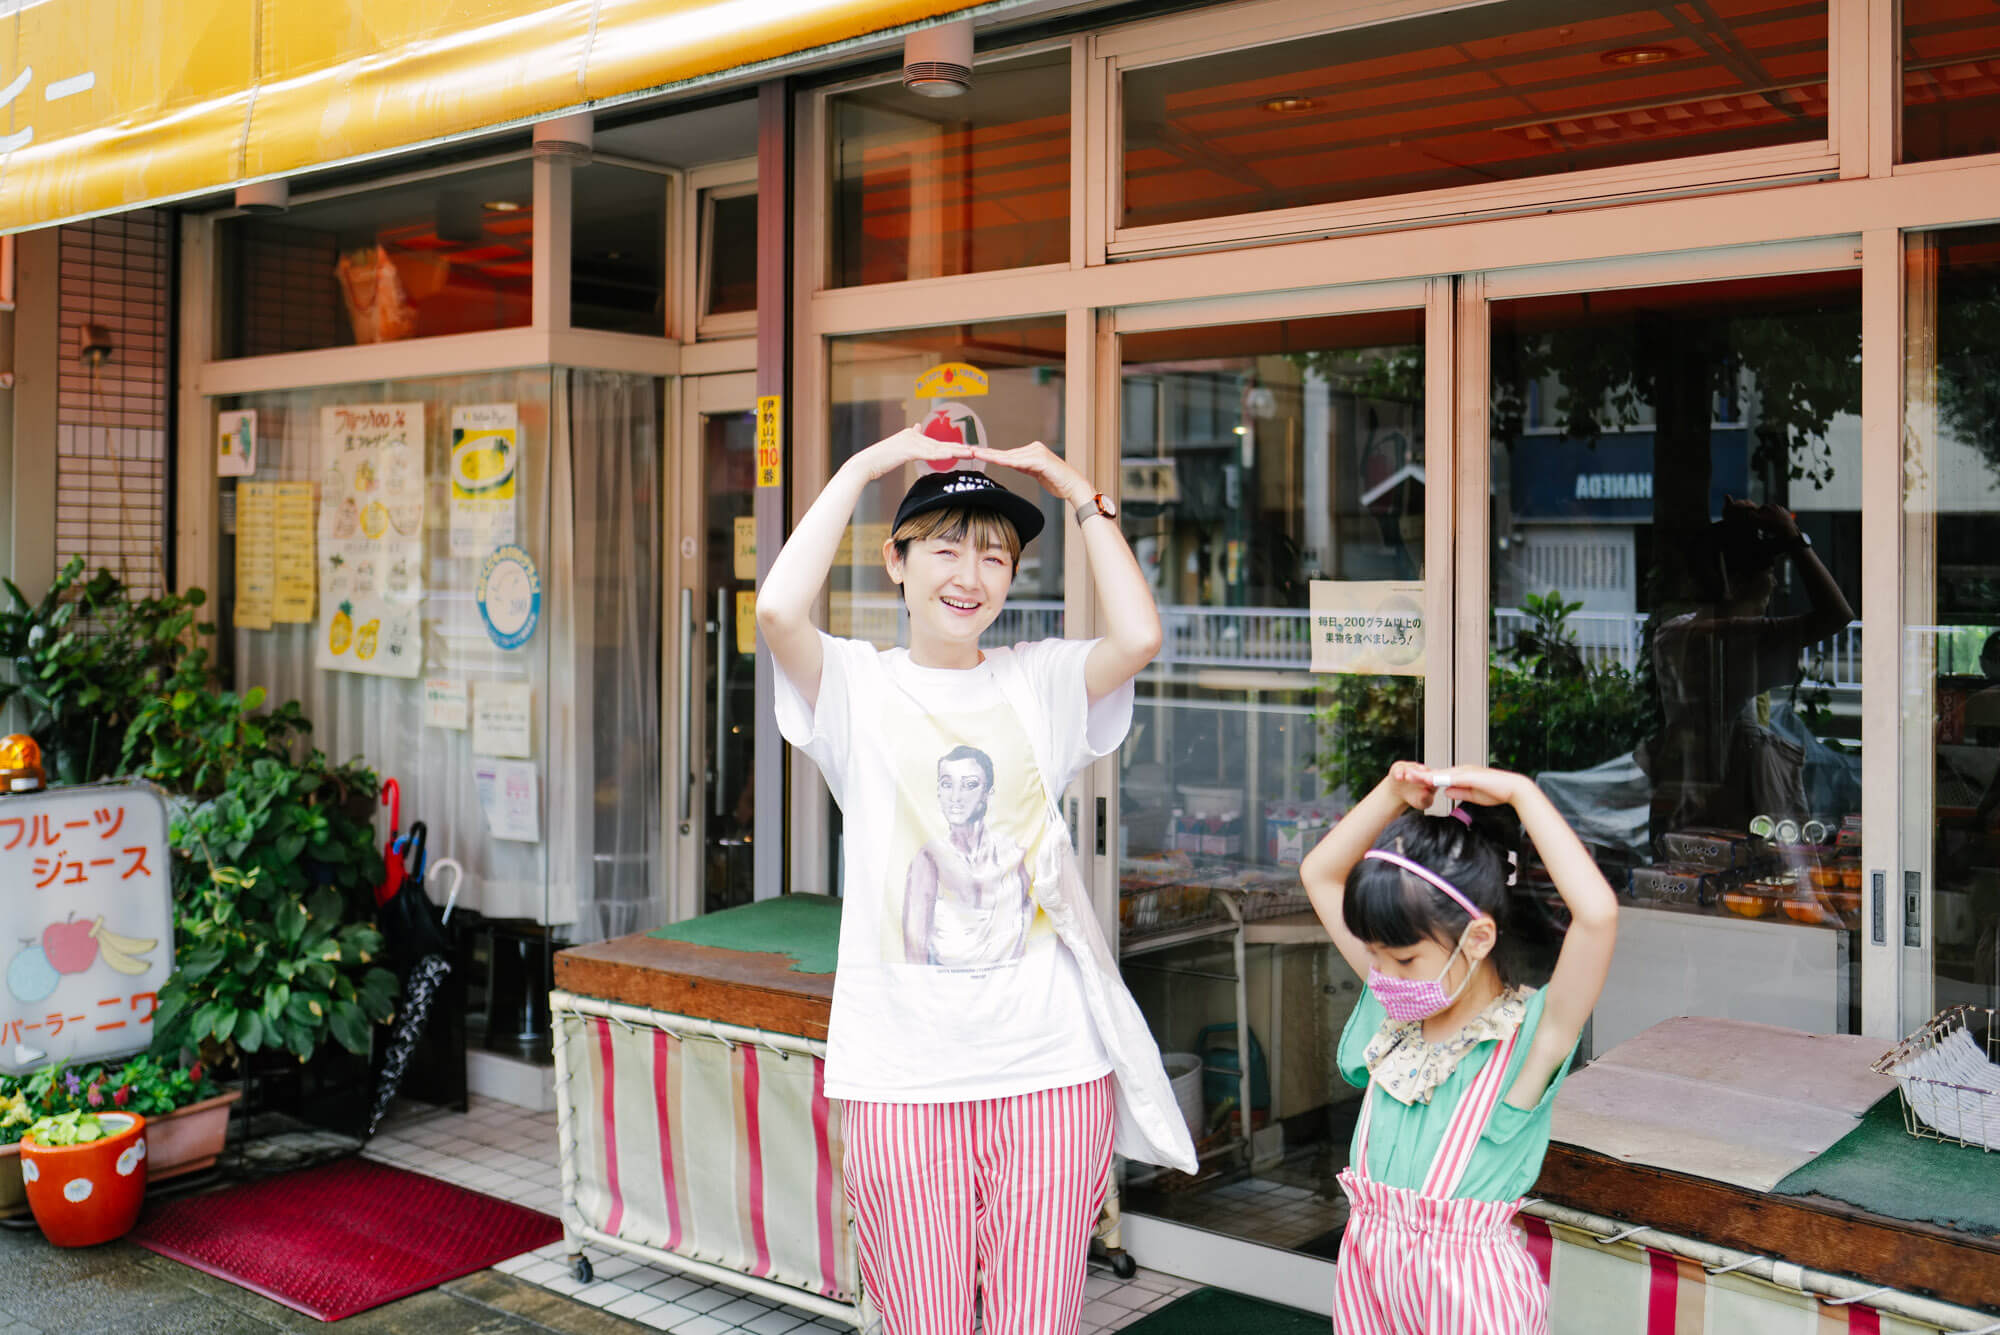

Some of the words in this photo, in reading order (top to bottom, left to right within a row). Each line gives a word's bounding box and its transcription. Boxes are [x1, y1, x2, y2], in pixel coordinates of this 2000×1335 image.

[0, 807, 125, 851] フルーツ
[32, 846, 152, 888] ジュース
